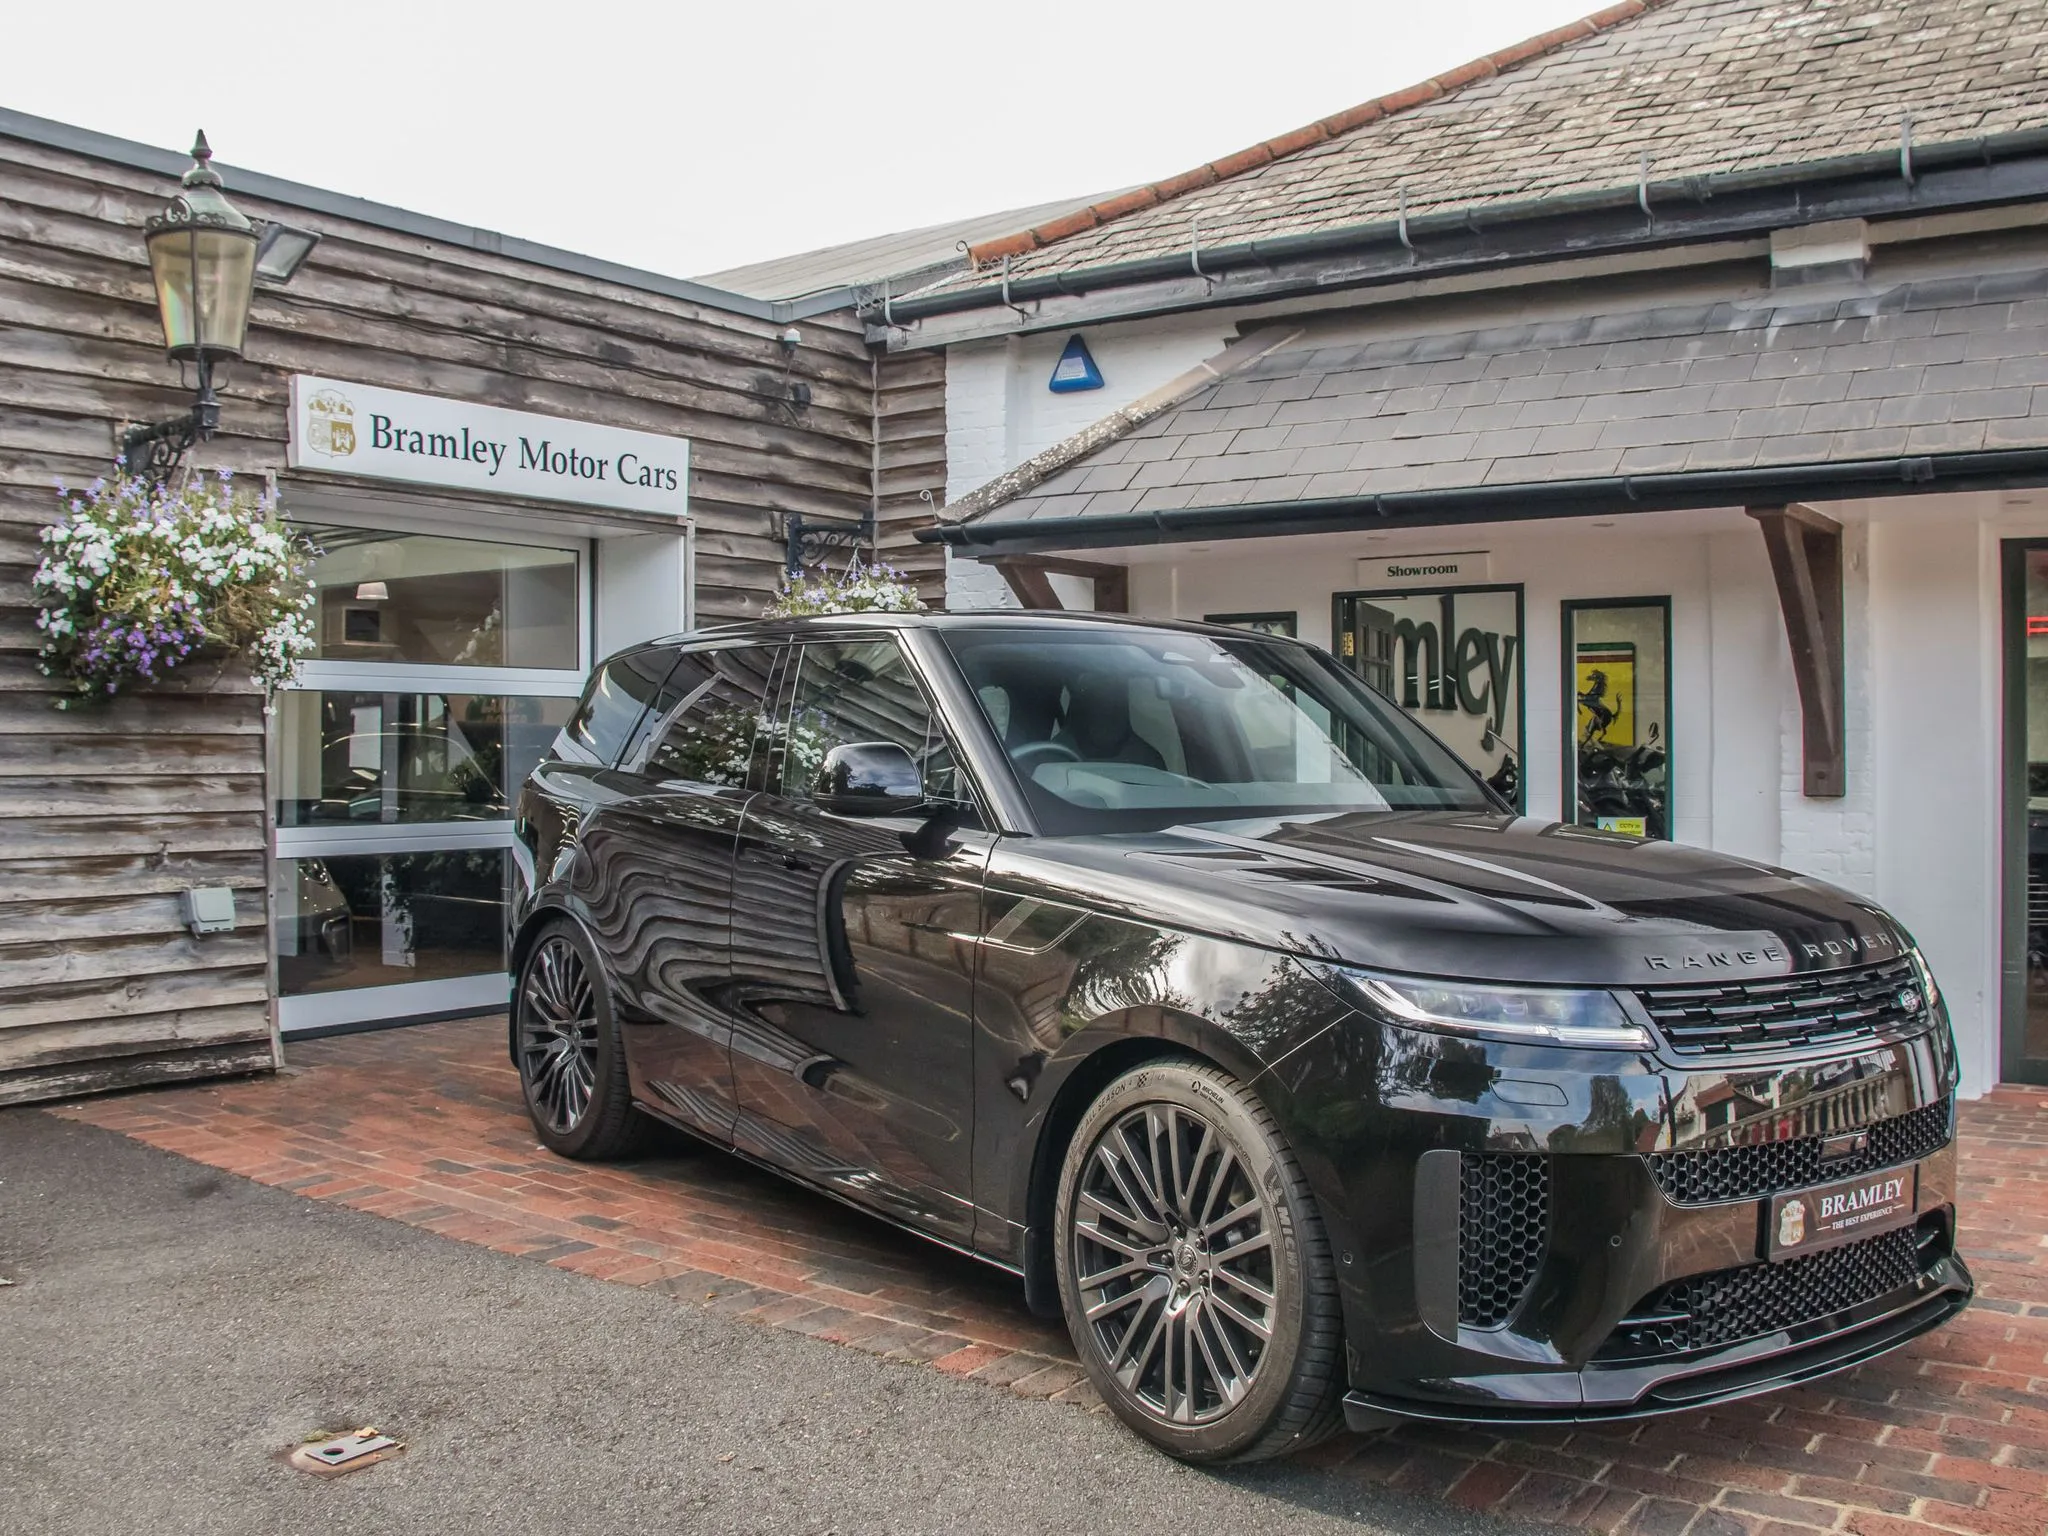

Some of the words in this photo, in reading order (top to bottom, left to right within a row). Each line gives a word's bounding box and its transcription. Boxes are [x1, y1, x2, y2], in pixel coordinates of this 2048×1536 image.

[369, 413, 507, 476] Bramley
[518, 436, 609, 480] Motor
[617, 453, 677, 491] Cars
[1386, 565, 1458, 577] Showroom
[1643, 947, 1784, 970] RANGE
[1802, 933, 1893, 958] ROVER
[1201, 1085, 1225, 1104] MICHELIN
[1821, 1177, 1904, 1218] BRAMLEY
[1832, 1220, 1844, 1230] THE
[1845, 1215, 1860, 1227] BEST
[1860, 1205, 1893, 1222] EXPERIENCE
